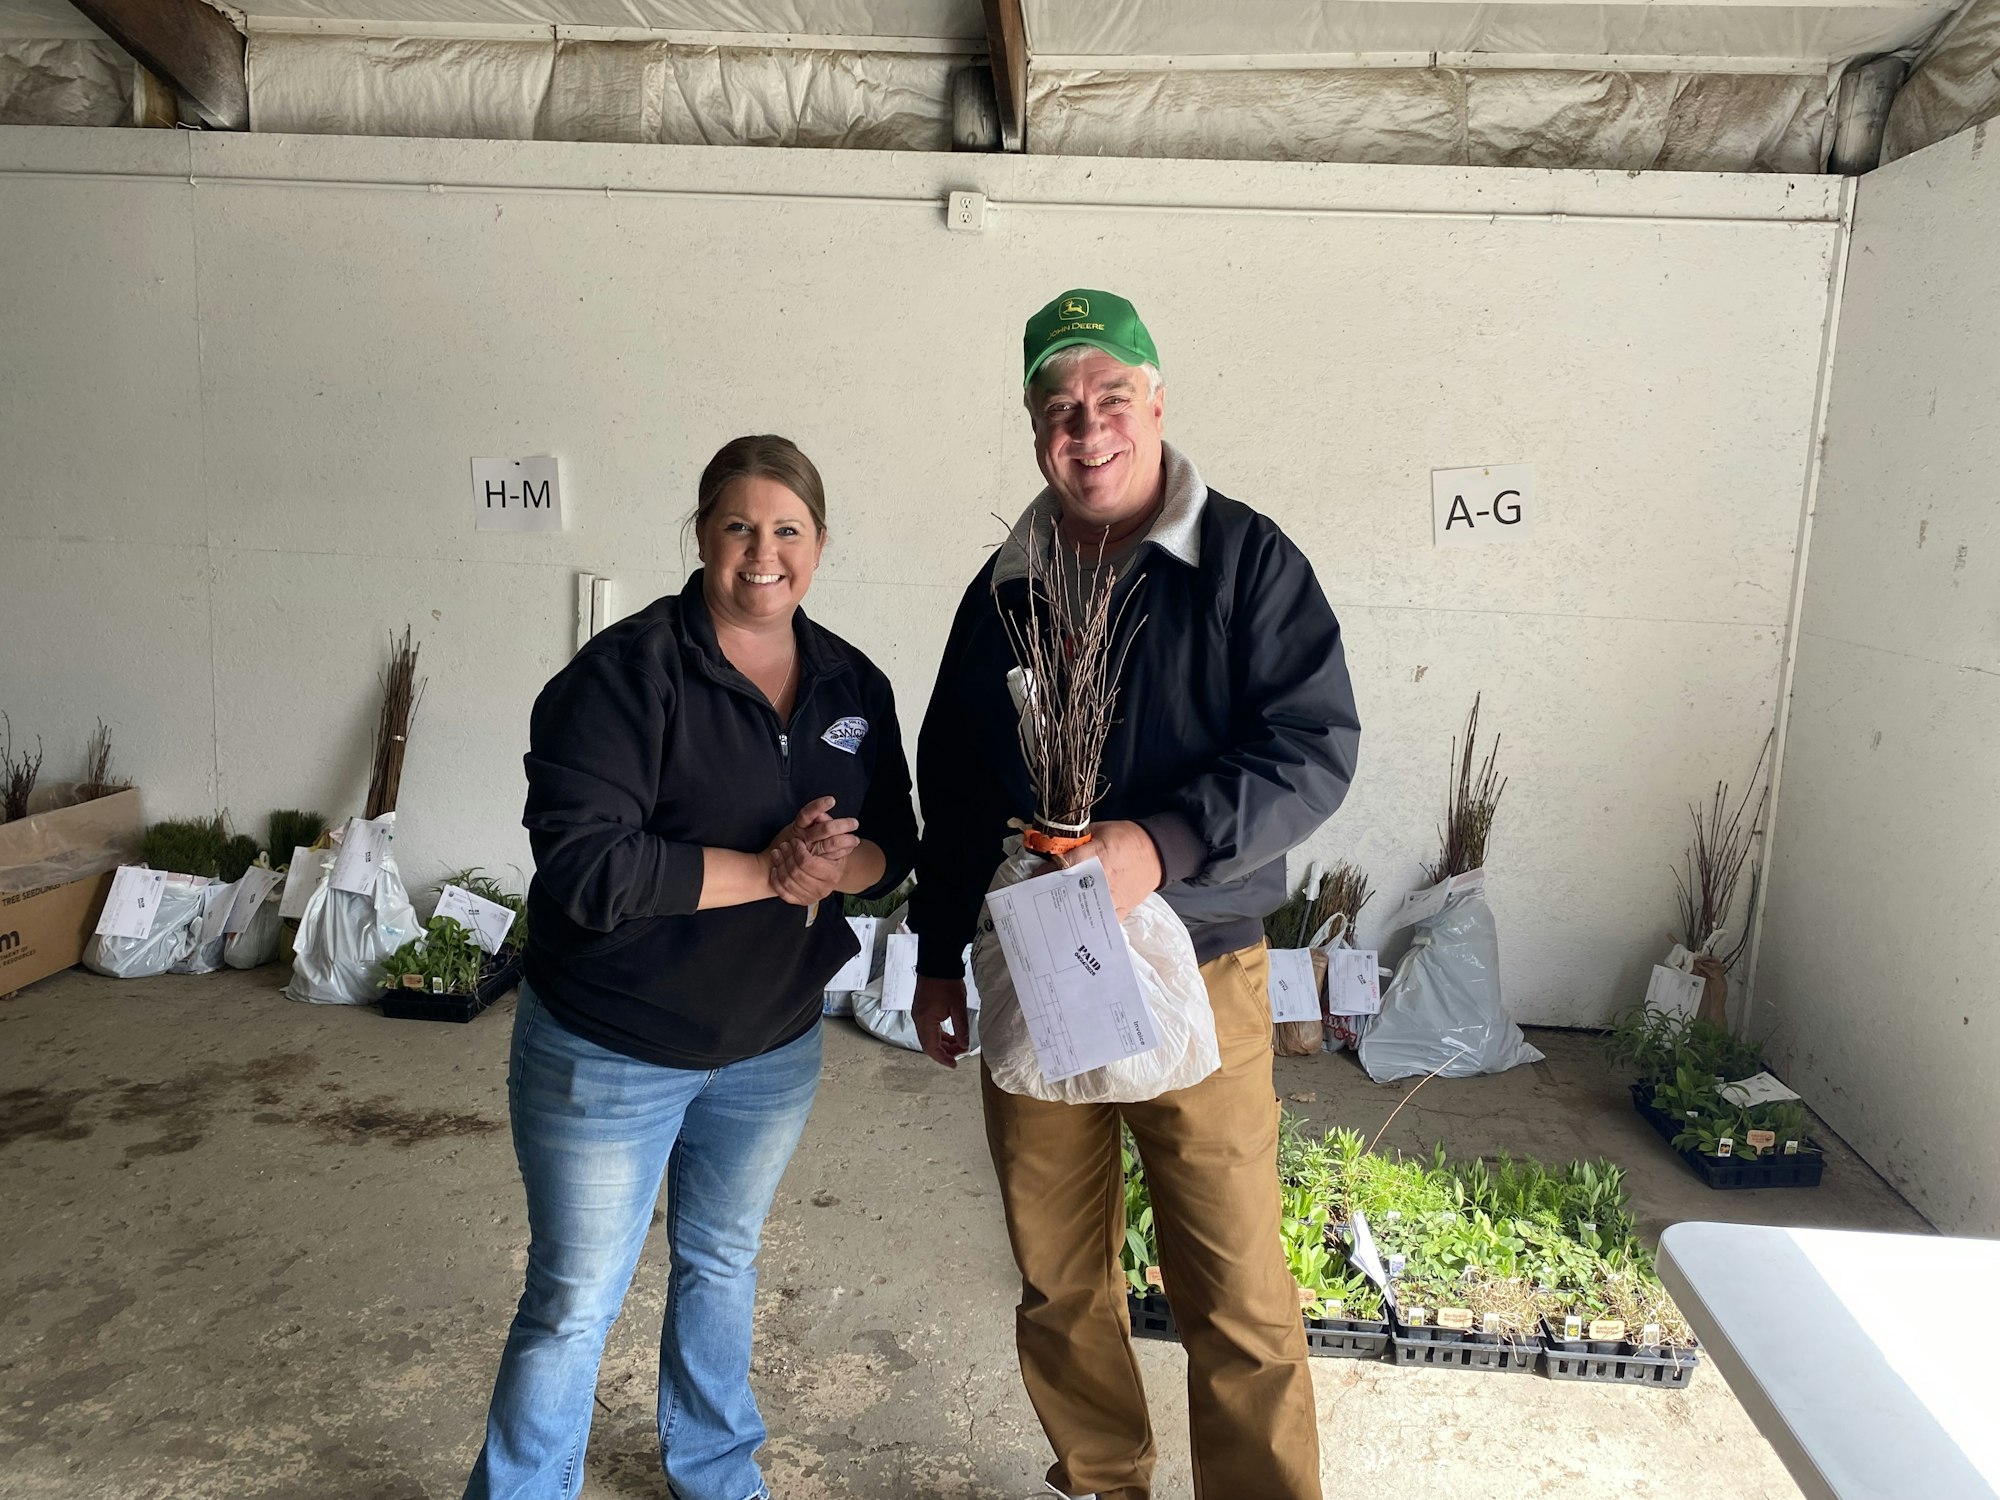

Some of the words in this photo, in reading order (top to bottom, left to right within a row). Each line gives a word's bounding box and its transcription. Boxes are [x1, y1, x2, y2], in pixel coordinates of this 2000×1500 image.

[1046, 325, 1071, 341] JOHN
[1071, 322, 1105, 331] DEERE
[485, 480, 550, 508] H-M
[1445, 489, 1521, 531] A-G
[2, 894, 21, 907] TREE
[1077, 945, 1101, 971] PAID
[1133, 1020, 1145, 1045] Invoice
